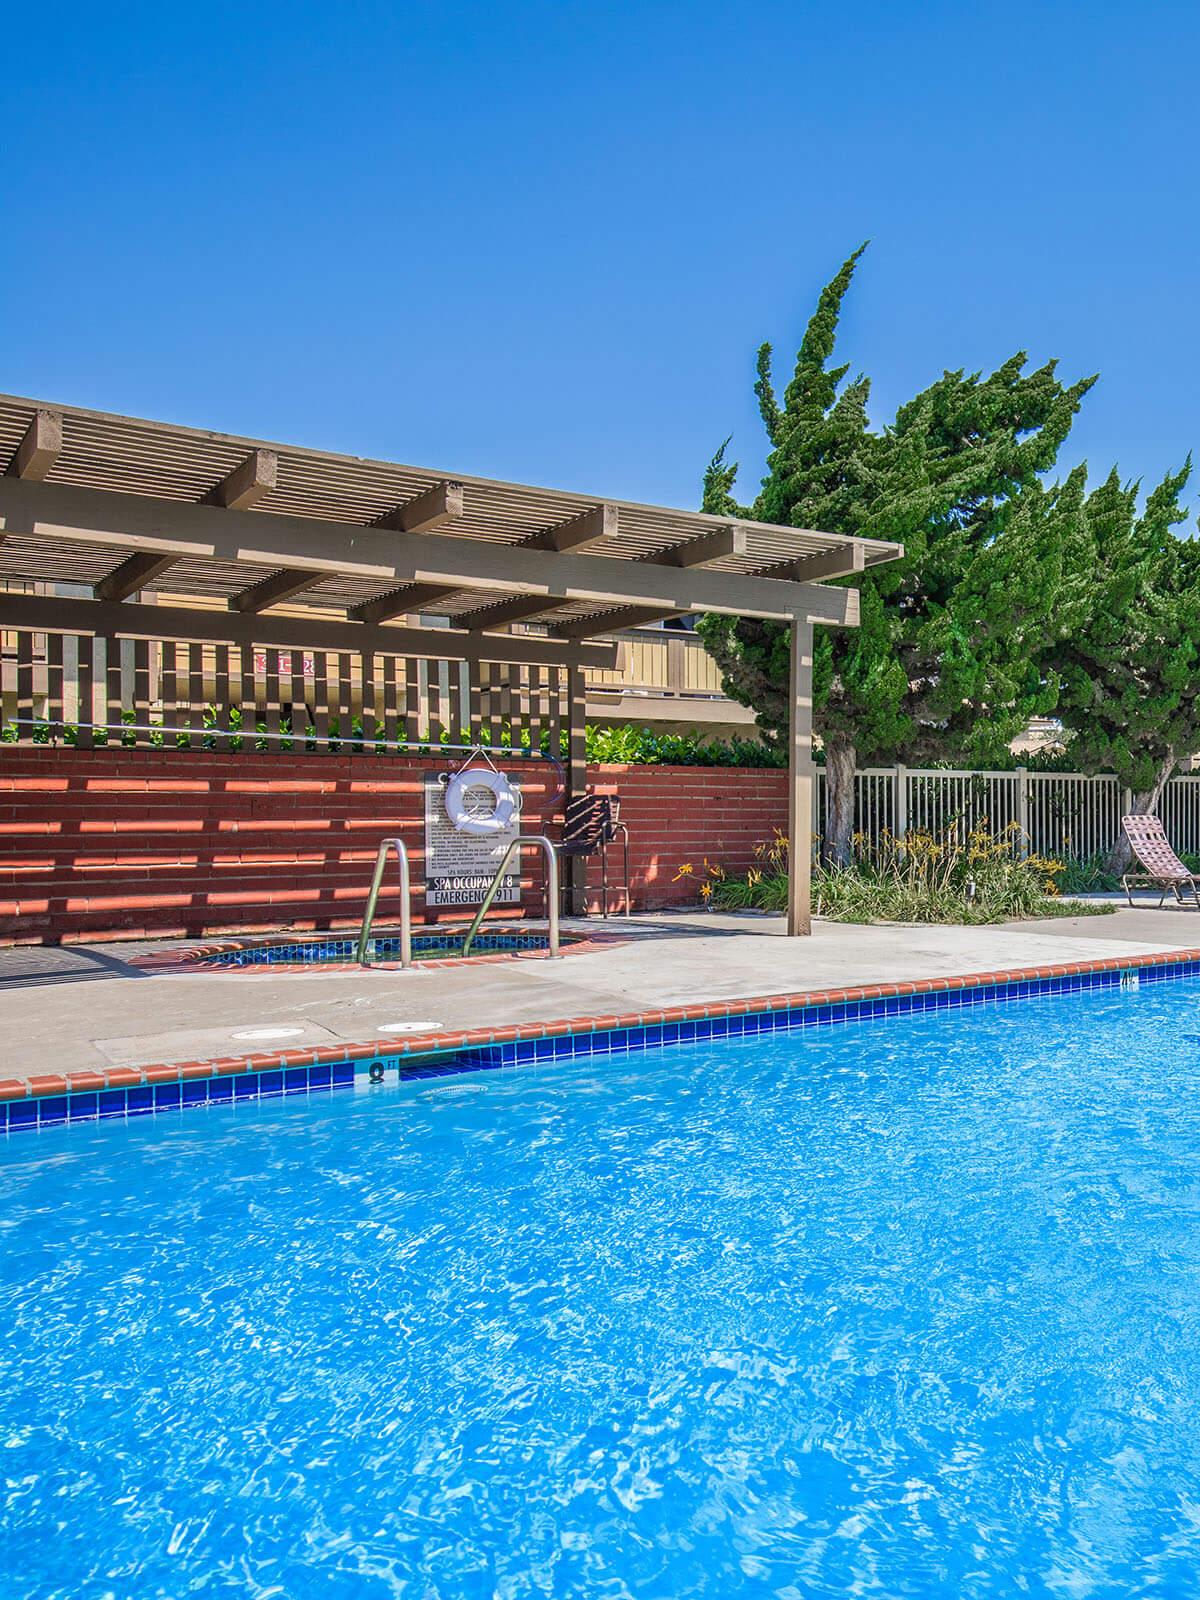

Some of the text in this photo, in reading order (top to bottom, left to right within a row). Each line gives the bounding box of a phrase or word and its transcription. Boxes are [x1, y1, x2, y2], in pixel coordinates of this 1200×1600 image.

[434, 875, 513, 890] SPA OCCUPAN 8
[434, 889, 512, 904] EMERGENC 911
